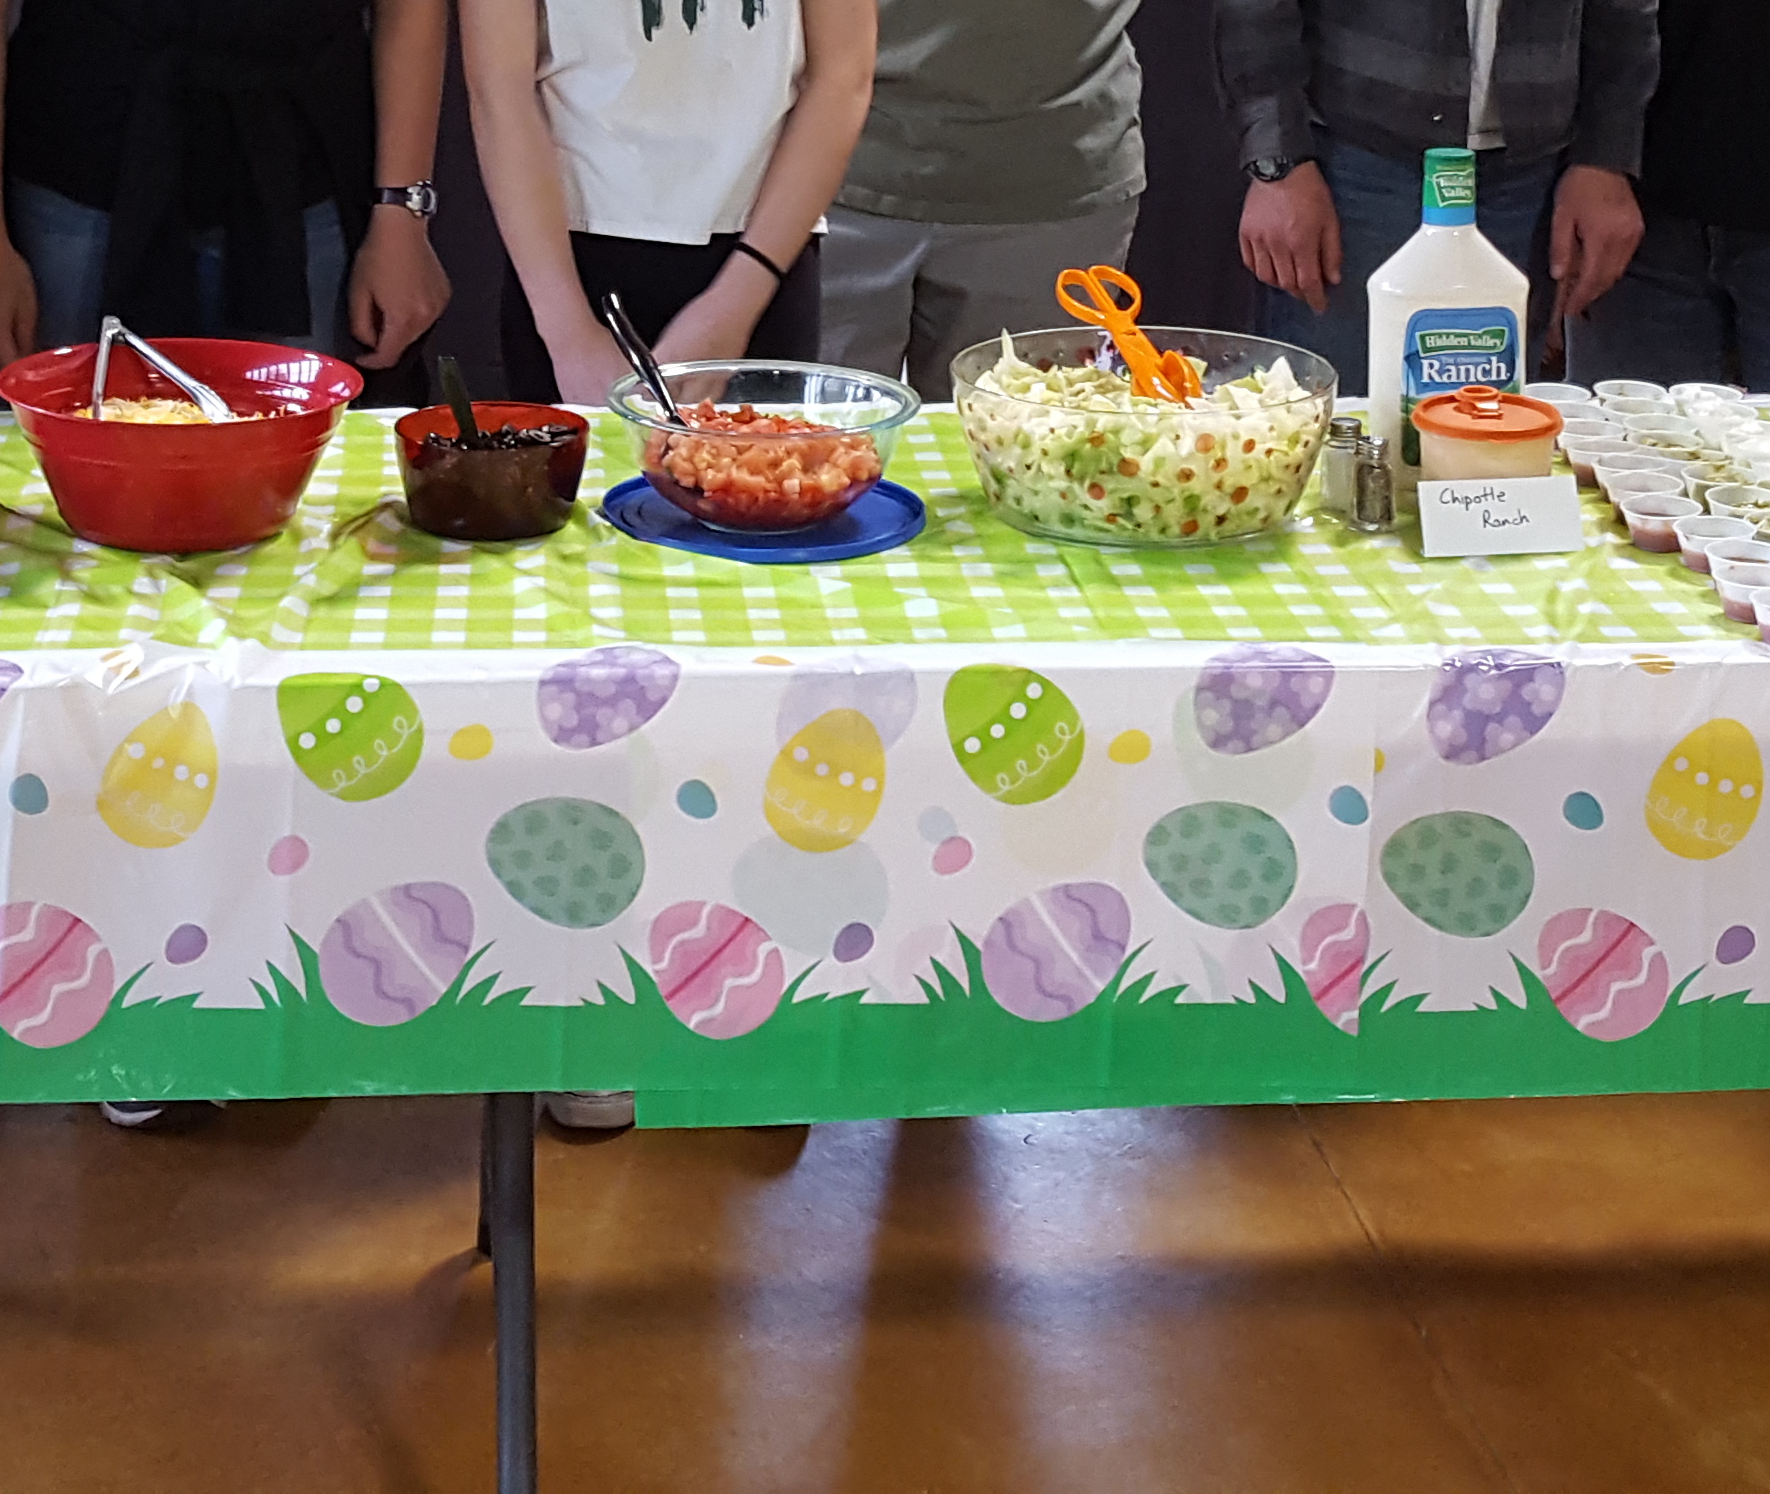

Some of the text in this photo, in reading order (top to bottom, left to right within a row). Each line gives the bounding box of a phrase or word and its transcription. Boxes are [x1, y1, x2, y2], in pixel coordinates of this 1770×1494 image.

[1425, 335, 1502, 350] Hidden Valley
[1439, 486, 1506, 511] Chipotle
[1482, 508, 1531, 528] Ranch
